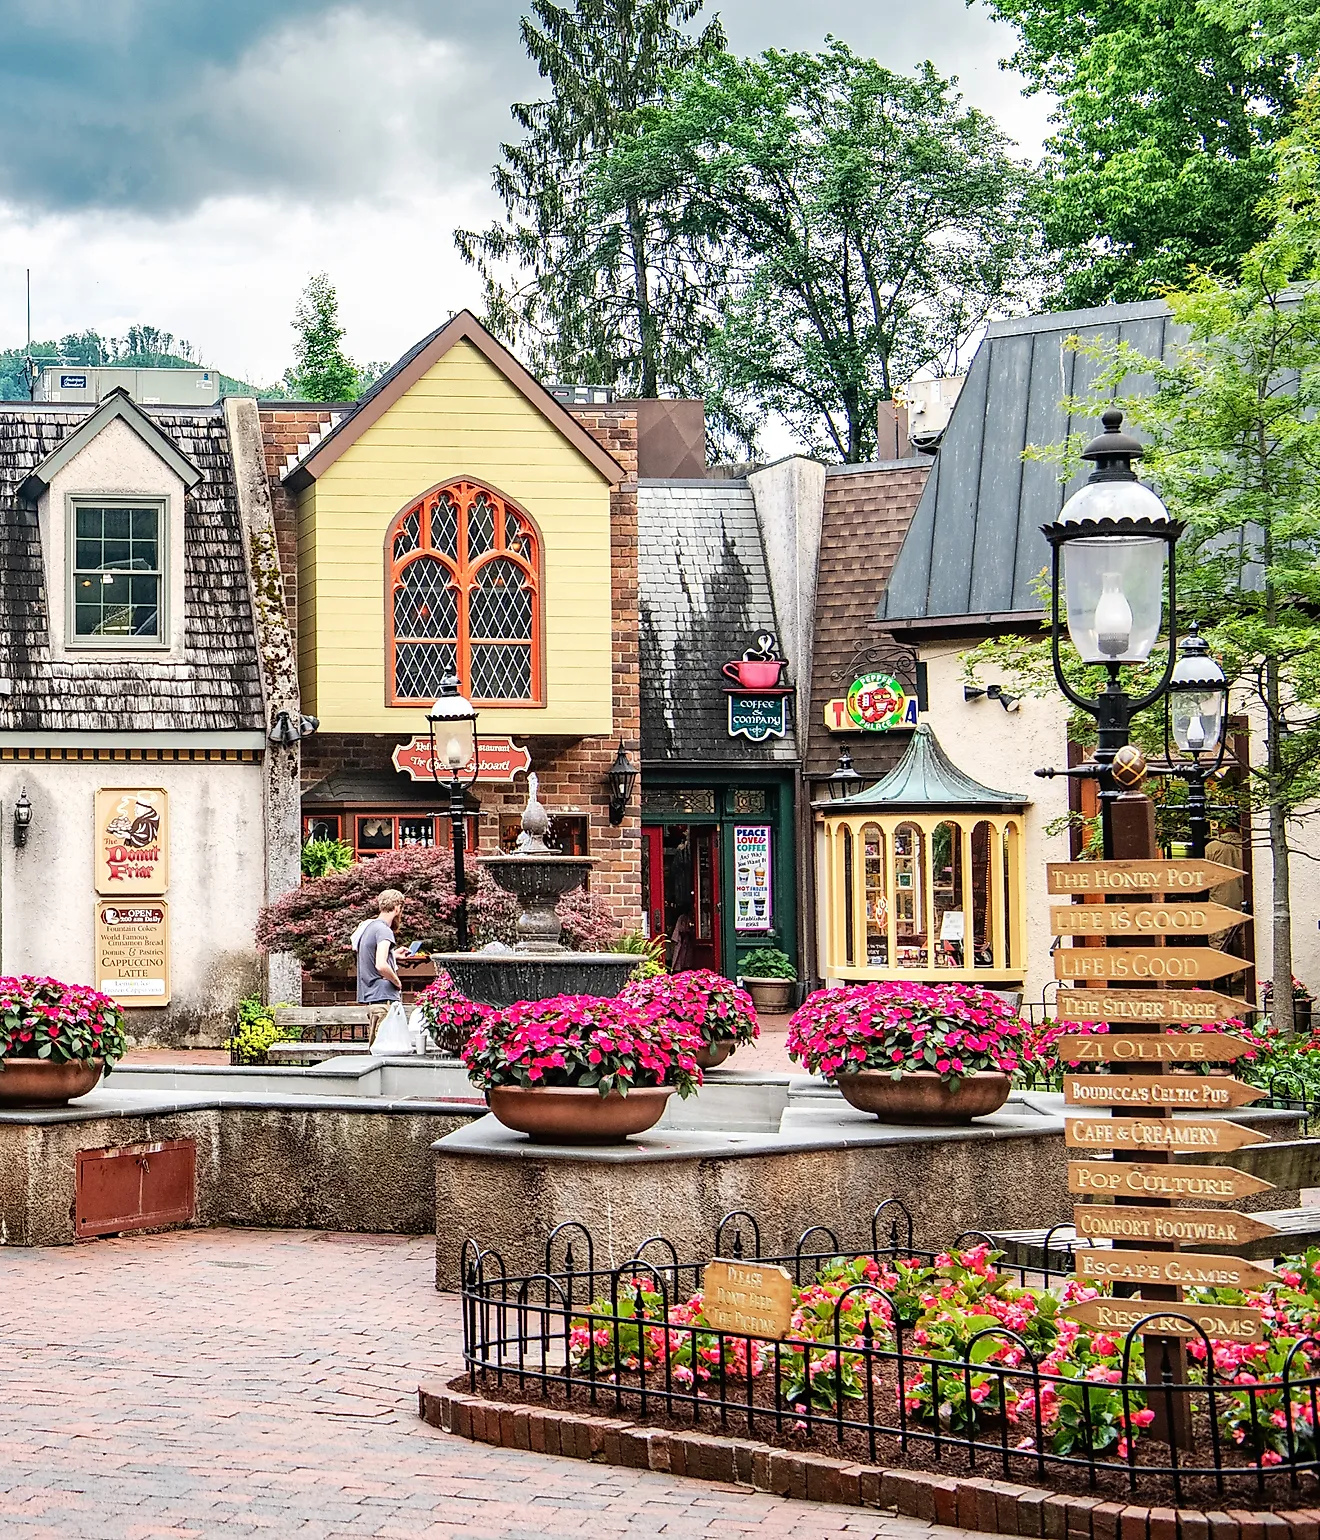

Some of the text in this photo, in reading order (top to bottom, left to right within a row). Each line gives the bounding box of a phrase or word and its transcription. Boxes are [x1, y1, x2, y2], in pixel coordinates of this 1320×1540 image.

[859, 674, 893, 684] PEPPER
[740, 700, 775, 708] COFFEE
[733, 716, 780, 726] COMPANY
[858, 719, 893, 730] PALACE
[410, 756, 426, 767] The
[105, 844, 160, 862] Donut
[736, 844, 766, 852] COFFEE
[106, 862, 154, 880] Friar
[1052, 868, 1205, 888] THE HONEY POT
[128, 909, 152, 917] OPEN
[1056, 910, 1208, 929] LIFE IS GOOD
[128, 948, 136, 956] &
[102, 957, 164, 967] CAPPUCCINO
[1060, 954, 1200, 977] LIFE IS GOOD
[118, 968, 148, 978] LATTE
[1062, 998, 1217, 1018] THE SILVER TREE
[1076, 1040, 1205, 1058] ZI OLIVE
[1072, 1082, 1230, 1103] BOUDICCA'S CELTIC PUB
[1072, 1120, 1221, 1145] CAFE & CREAMERY
[1077, 1168, 1234, 1195] POP CULTURE
[1080, 1215, 1238, 1241] COMFORT FOOTWEAR
[728, 1266, 762, 1287] PLEASE
[1082, 1256, 1241, 1284] ESCAPE GAMES
